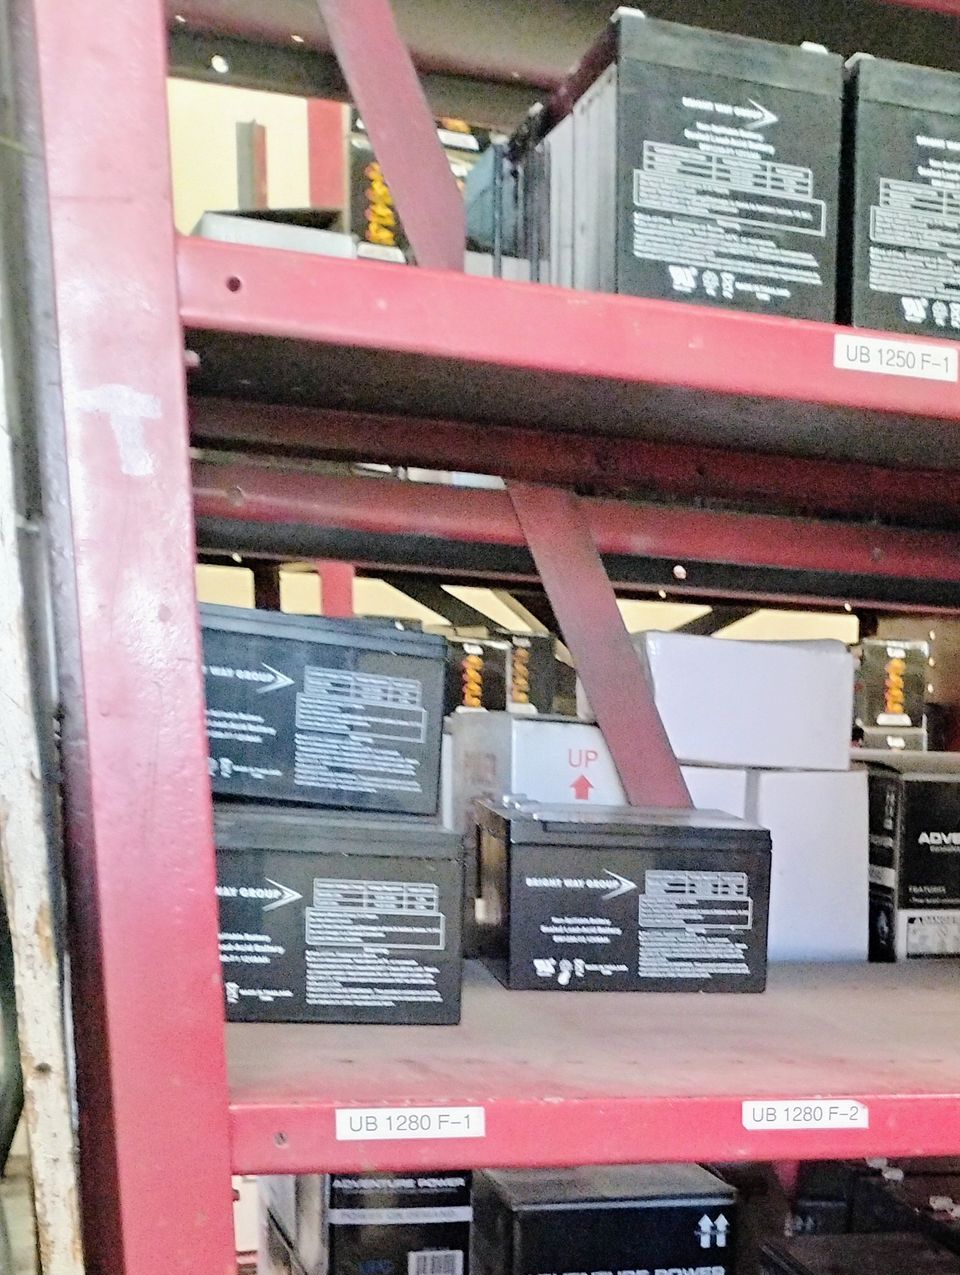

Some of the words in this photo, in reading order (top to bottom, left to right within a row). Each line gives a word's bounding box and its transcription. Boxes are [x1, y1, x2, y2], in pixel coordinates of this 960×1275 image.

[846, 345, 871, 363] UB
[878, 348, 916, 369] 1250
[921, 353, 949, 373] F-1
[568, 748, 599, 768] UP
[349, 1116, 378, 1132] UB
[386, 1114, 431, 1131] 1280
[438, 1114, 470, 1130] F-1
[752, 1107, 777, 1123] UB
[784, 1106, 823, 1122] 1280
[828, 1106, 859, 1121] F-2
[332, 1178, 417, 1189] ADVENTURE
[417, 1177, 466, 1188] POWER
